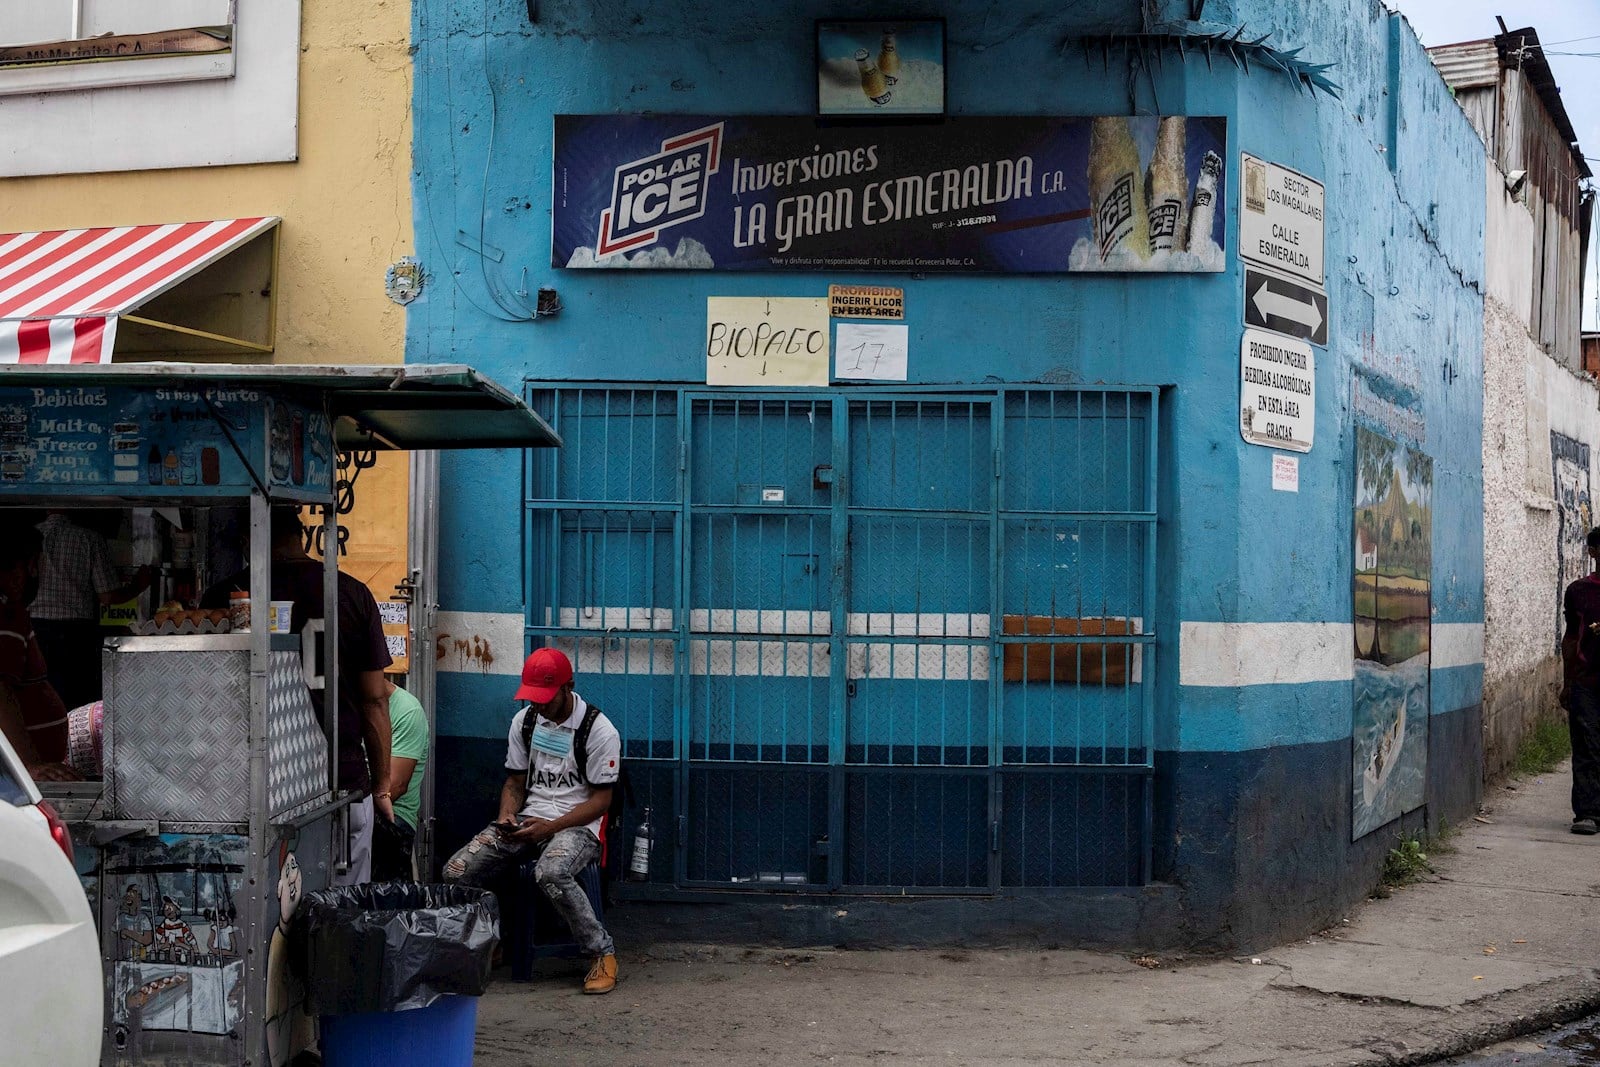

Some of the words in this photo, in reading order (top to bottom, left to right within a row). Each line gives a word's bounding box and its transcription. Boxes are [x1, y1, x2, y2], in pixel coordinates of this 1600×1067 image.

[622, 152, 701, 192] POLAR
[732, 144, 879, 195] Inversiones
[1283, 176, 1310, 199] SECTOR
[617, 171, 700, 231] ICE
[733, 202, 767, 248] LA
[774, 187, 853, 253] GRAN
[862, 155, 1033, 226] ESMERALDA
[1041, 170, 1067, 194] C.A.
[1267, 186, 1280, 204] LOS
[1281, 192, 1322, 222] MAGALLANES
[1101, 195, 1131, 238] ICE
[1150, 216, 1175, 235] CE
[1272, 223, 1299, 246] CALLE
[789, 256, 812, 265] disfruta
[812, 257, 824, 265] con
[881, 257, 888, 265] lo
[888, 257, 914, 266] recuerda
[1259, 239, 1310, 270] ESMERALDA
[831, 296, 872, 306] INGERIR
[873, 297, 903, 307] LICOR
[832, 286, 903, 297] PROHIBIDO
[831, 306, 846, 315] EN
[847, 306, 872, 316] ESTA
[874, 307, 903, 317] AREA
[708, 322, 824, 358] BIOPAGO
[847, 341, 885, 374] 17
[1250, 341, 1283, 364] PROHIBIDO
[1284, 349, 1307, 370] INGERIR
[1245, 366, 1272, 387] BEBIDAS
[1272, 373, 1311, 396] ALCOHÓLICAS
[30, 387, 108, 408] Bebidas
[205, 388, 260, 402] Punto
[1258, 395, 1267, 411] EN
[1268, 398, 1283, 415] ESTA
[1284, 396, 1300, 419] ÁREA
[37, 418, 102, 434] Malta
[1266, 422, 1293, 442] GRACIAS
[33, 436, 98, 452] Fresco
[101, 605, 138, 620] PIERNA
[528, 770, 583, 789] APAN
